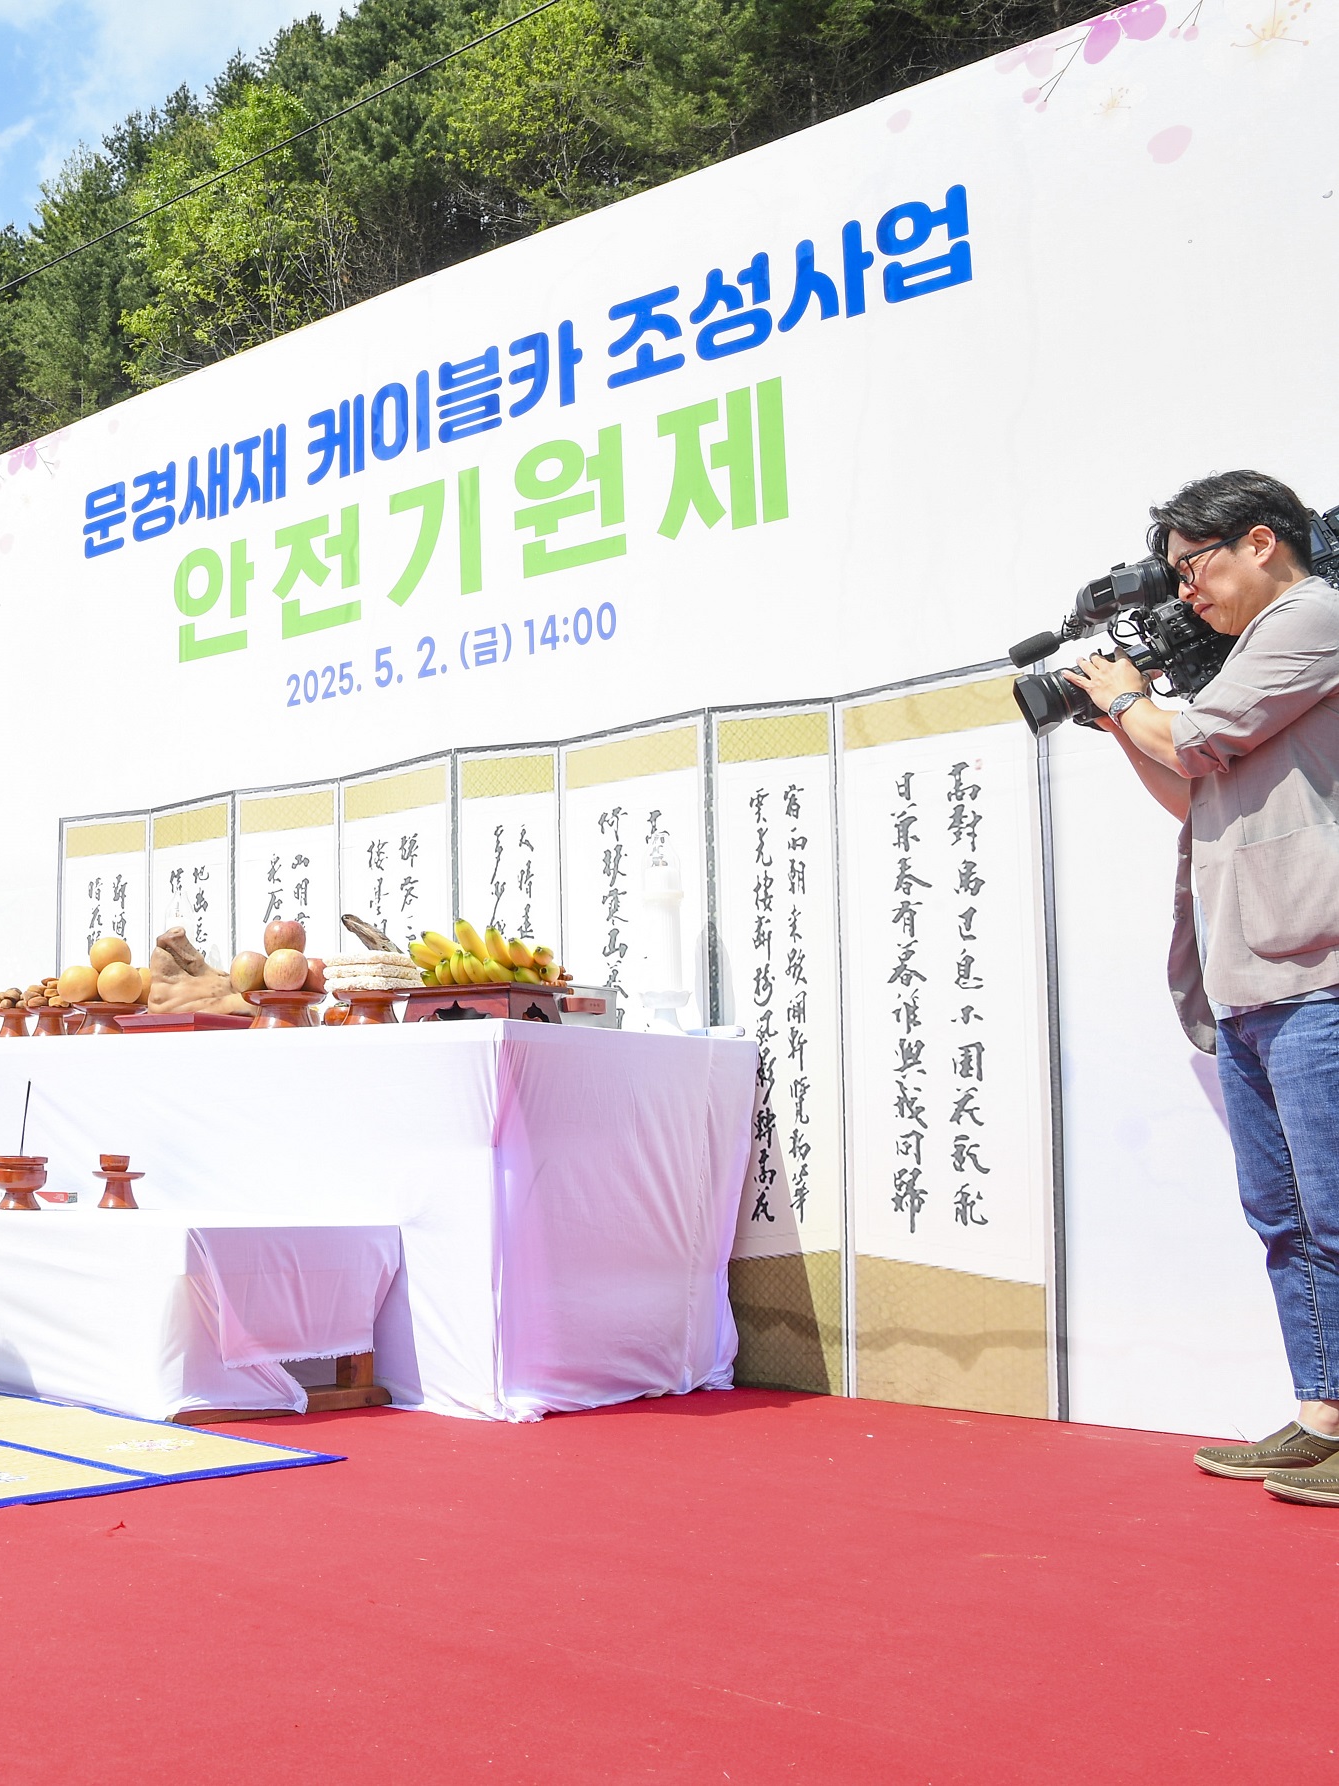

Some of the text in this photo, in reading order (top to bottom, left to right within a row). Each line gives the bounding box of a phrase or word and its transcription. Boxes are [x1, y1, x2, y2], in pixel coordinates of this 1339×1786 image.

[83, 183, 973, 559] 문경새재 케이블카 조성사업
[173, 376, 789, 663] 안전기원제
[286, 601, 618, 707] 2025. 5. 2. (금) 14:00
